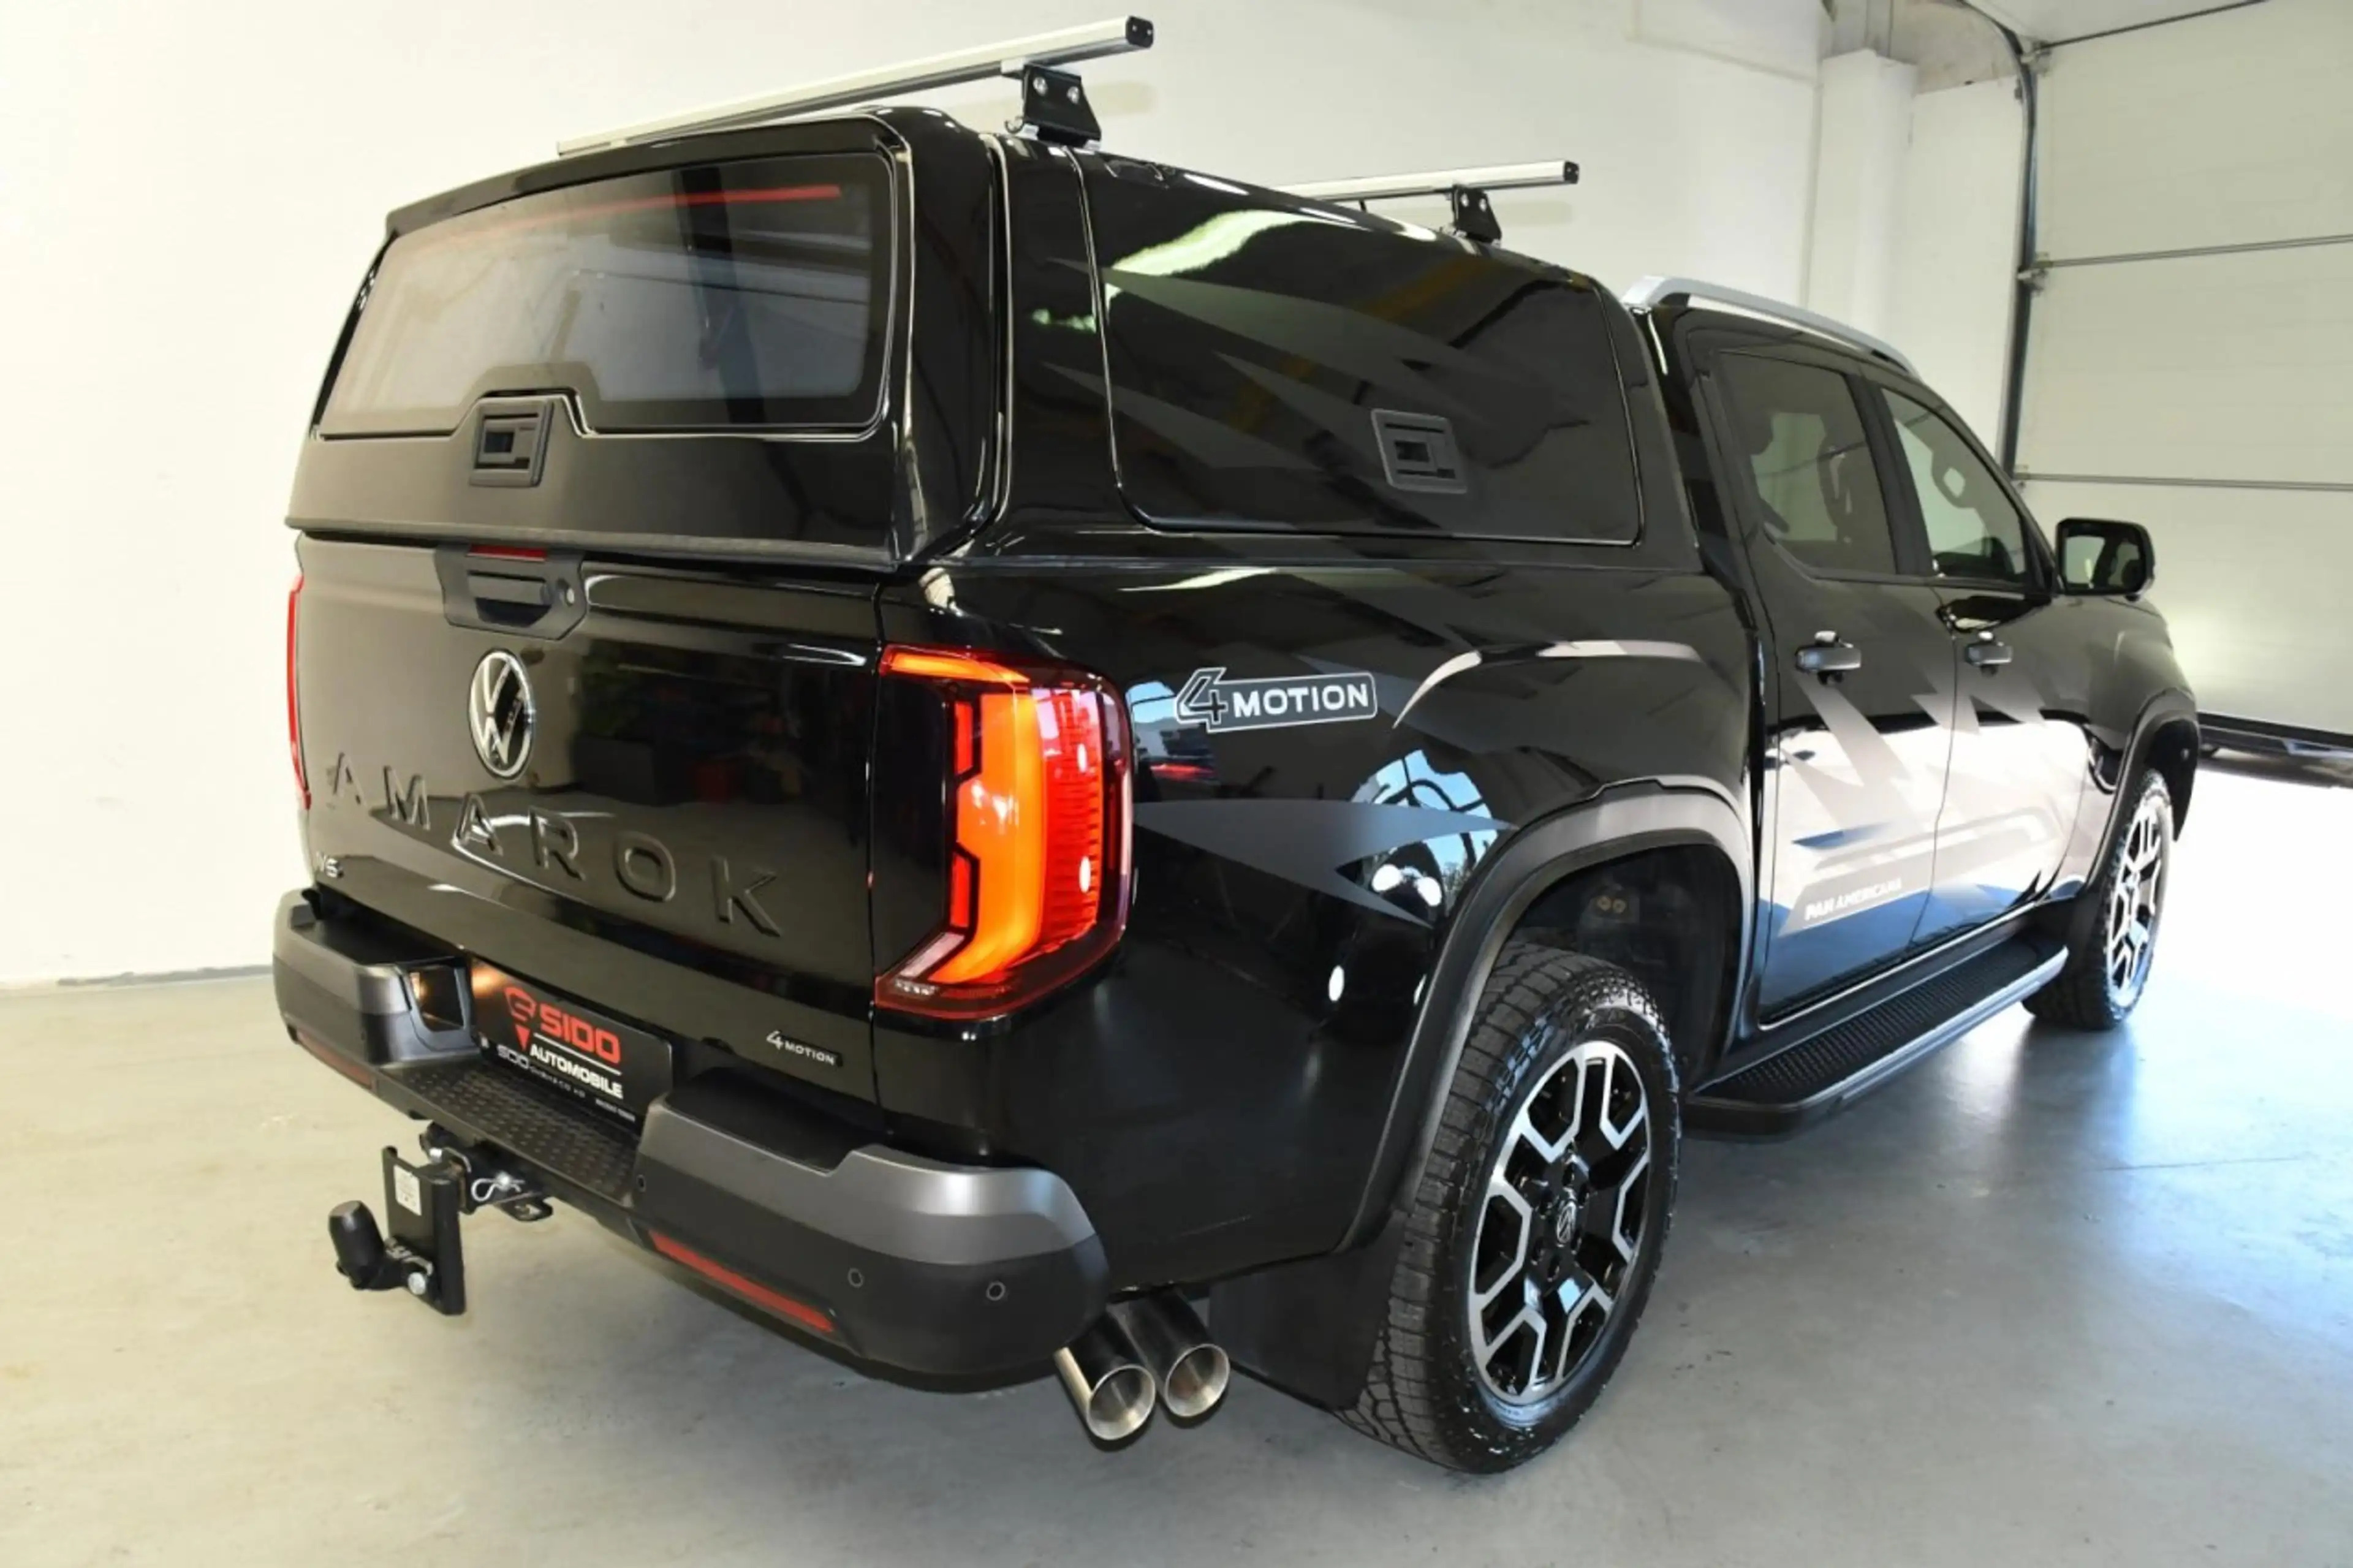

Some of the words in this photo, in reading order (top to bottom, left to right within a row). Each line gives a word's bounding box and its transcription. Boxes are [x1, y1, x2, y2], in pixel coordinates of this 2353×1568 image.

[1175, 668, 1373, 729] 4MOTION
[332, 752, 778, 937] AMAROK
[539, 1002, 621, 1064] SIDO
[530, 1043, 624, 1100] AUTOMOBILE
